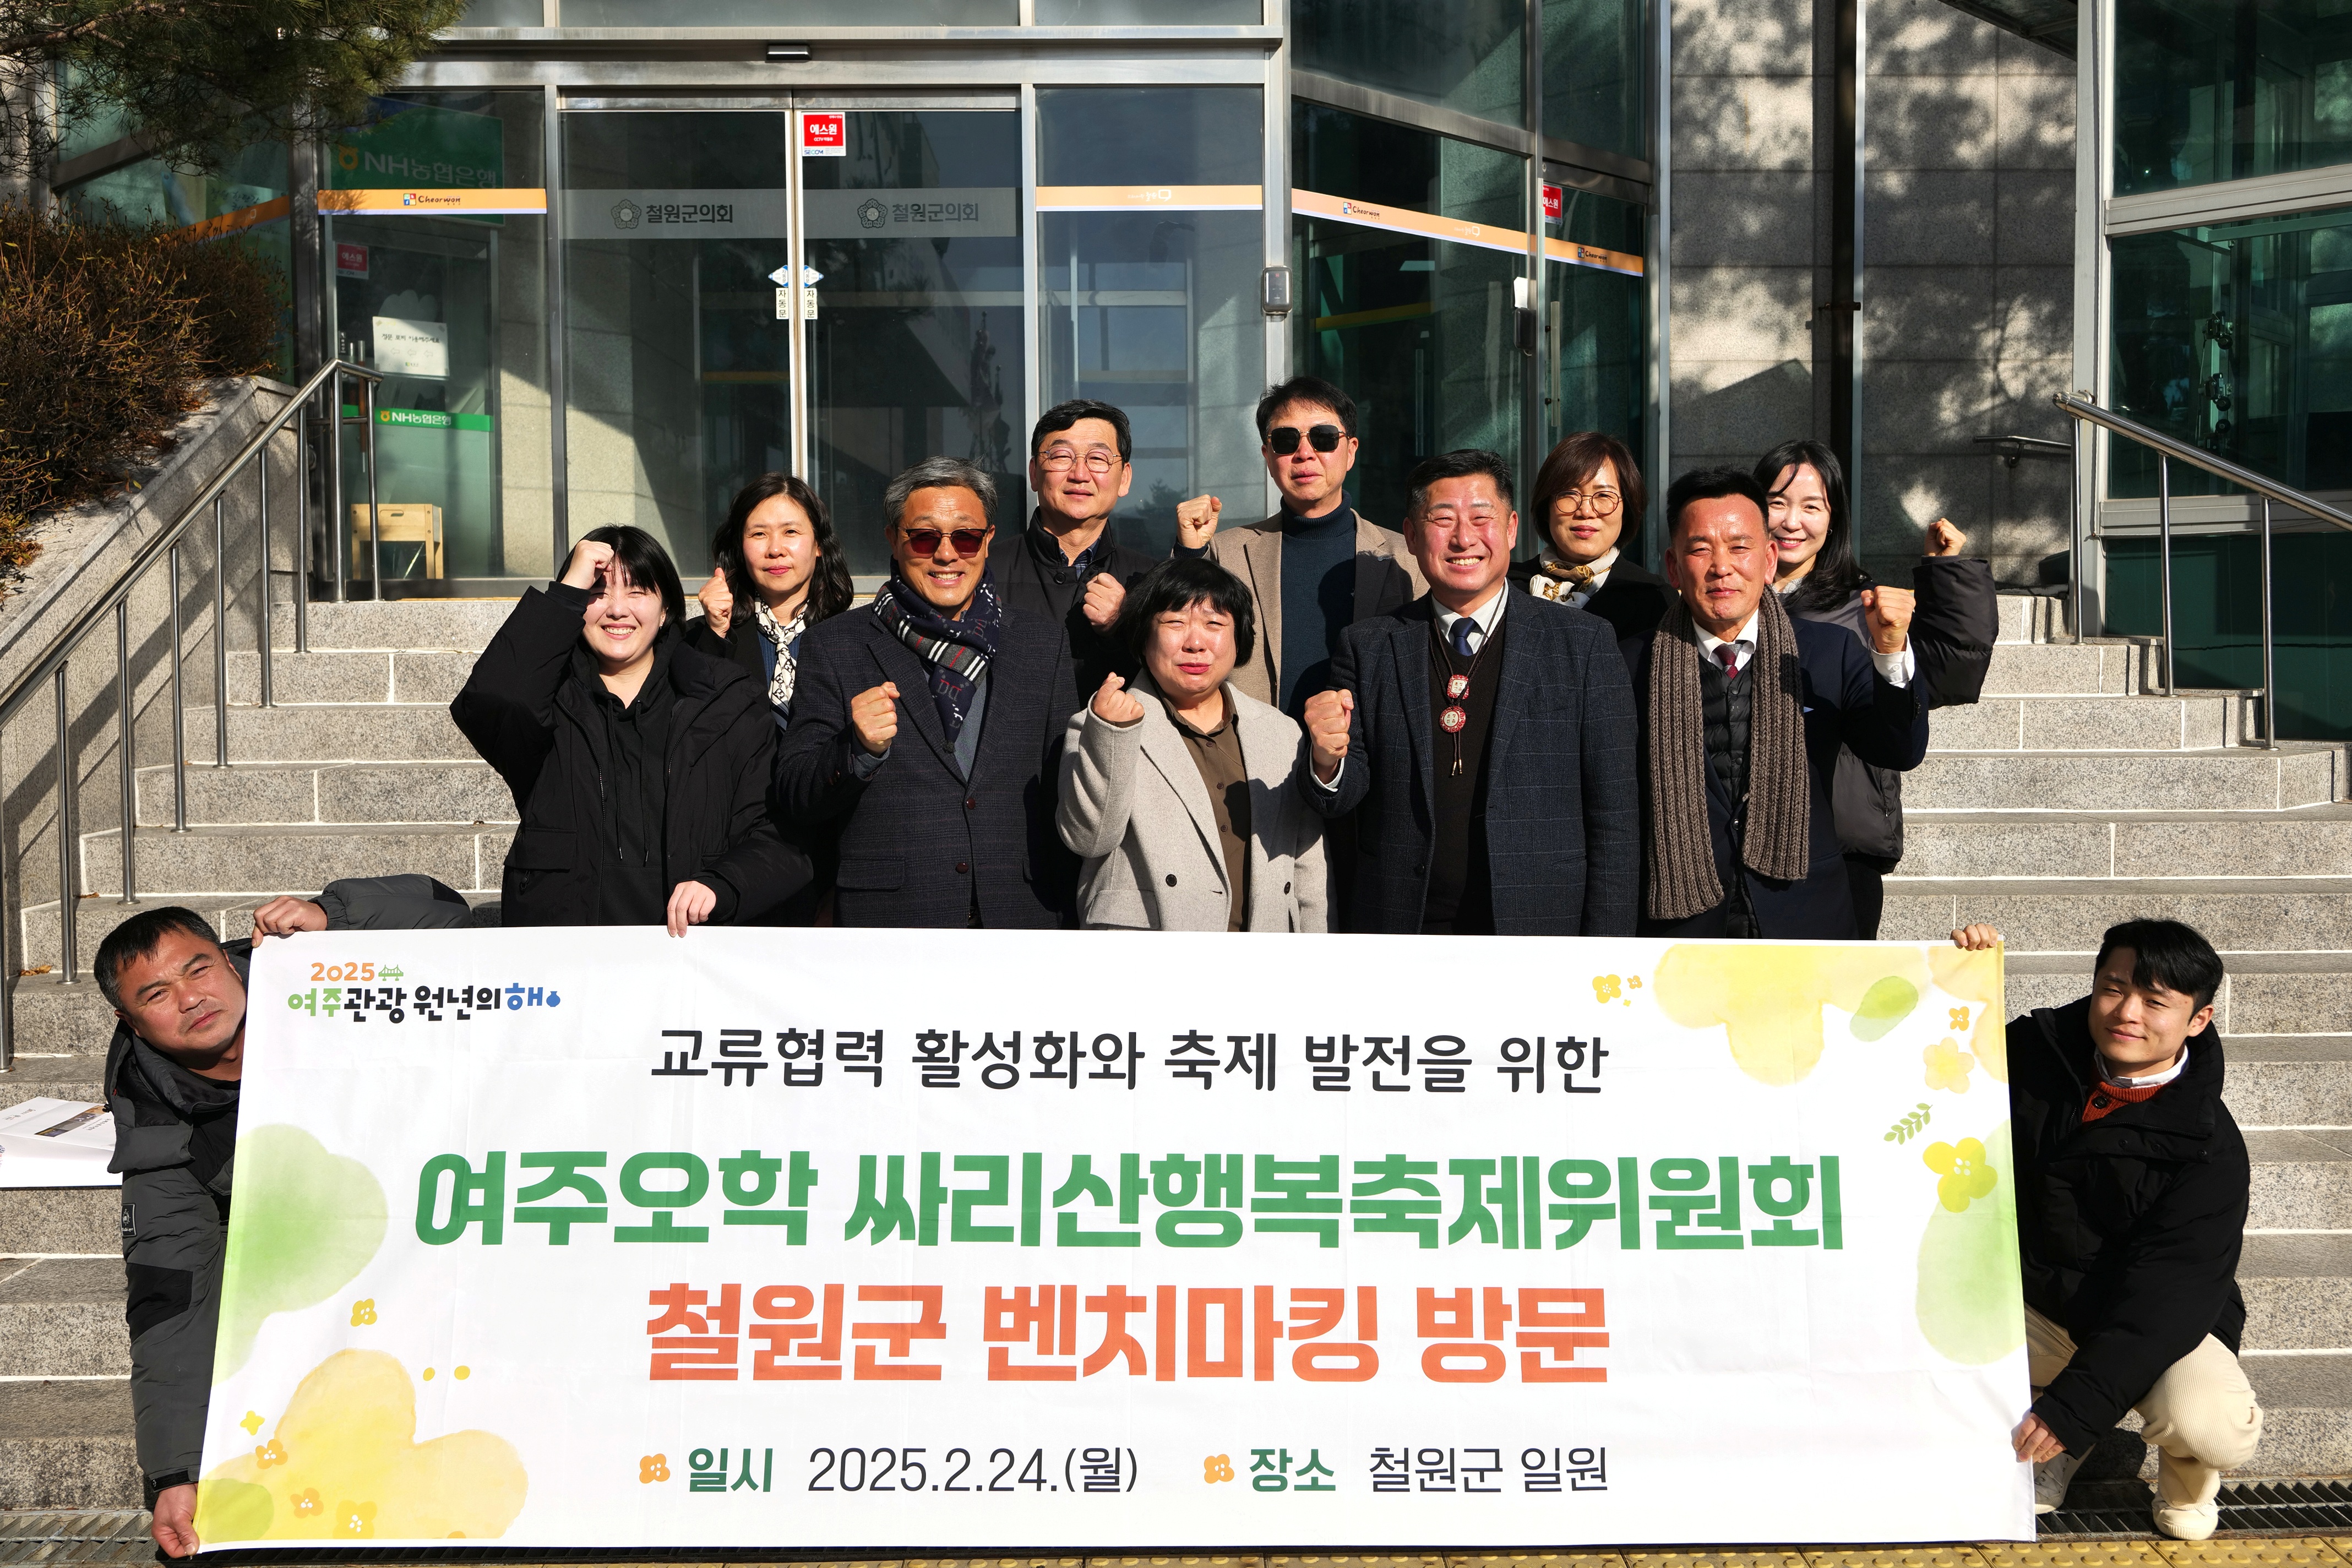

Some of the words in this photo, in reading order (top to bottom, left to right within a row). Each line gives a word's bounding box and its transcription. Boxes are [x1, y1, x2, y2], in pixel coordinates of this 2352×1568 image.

[809, 124, 837, 135] 에스원
[364, 151, 496, 189] NH농협은행
[646, 204, 733, 224] 철원군의회
[892, 203, 979, 222] 철원군의회
[1353, 206, 1380, 217] Cheorwon
[1543, 197, 1559, 209] 에스원
[778, 289, 786, 318] 자동문
[807, 290, 815, 318] 자동문
[391, 412, 451, 426] NH농협은행
[311, 962, 374, 982] 2025
[651, 1028, 884, 1088] 교류협력
[912, 1028, 1146, 1090] 활성화와
[1164, 1029, 1276, 1091] 축제
[1305, 1034, 1473, 1093] 발전을
[1497, 1036, 1610, 1094] 위한
[415, 1150, 819, 1246] 여주오학
[844, 1152, 1843, 1250] 싸리산행복축제위원회
[646, 1283, 946, 1381] 철원군
[983, 1284, 1380, 1382] 벤치마킹
[1416, 1286, 1610, 1383] 방문
[688, 1447, 773, 1493] 일시
[808, 1447, 1137, 1493] 2025.2.24.(월)
[1249, 1448, 1336, 1492] 장소
[1369, 1447, 1504, 1493] 철원군
[1521, 1447, 1608, 1493] 일원
